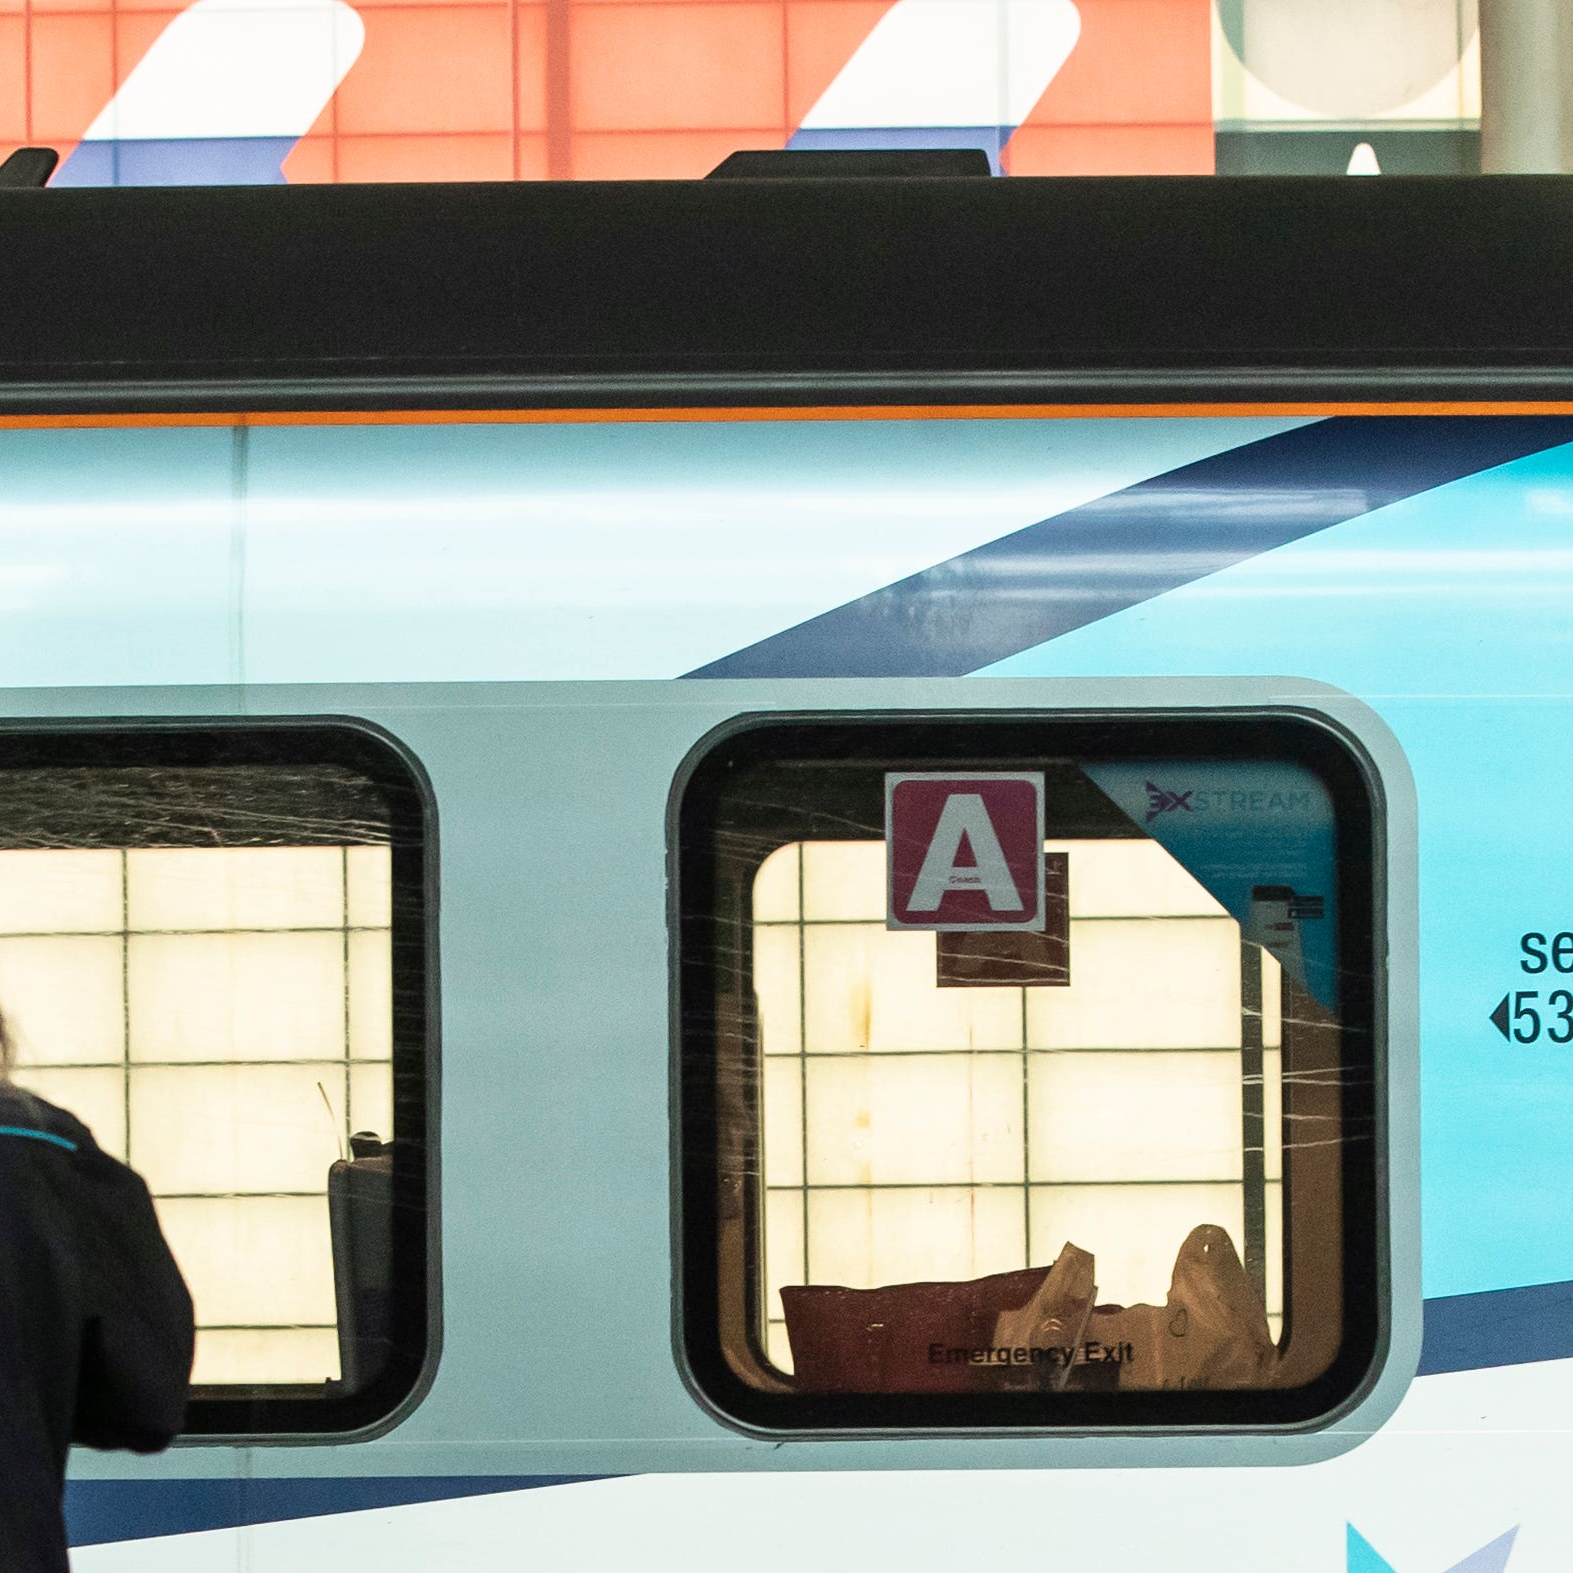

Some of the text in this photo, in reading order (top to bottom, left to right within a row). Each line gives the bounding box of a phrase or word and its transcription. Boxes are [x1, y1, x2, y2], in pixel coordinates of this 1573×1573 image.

[905, 793, 1025, 912] A
[928, 1341, 1134, 1366] Emergency Exit
